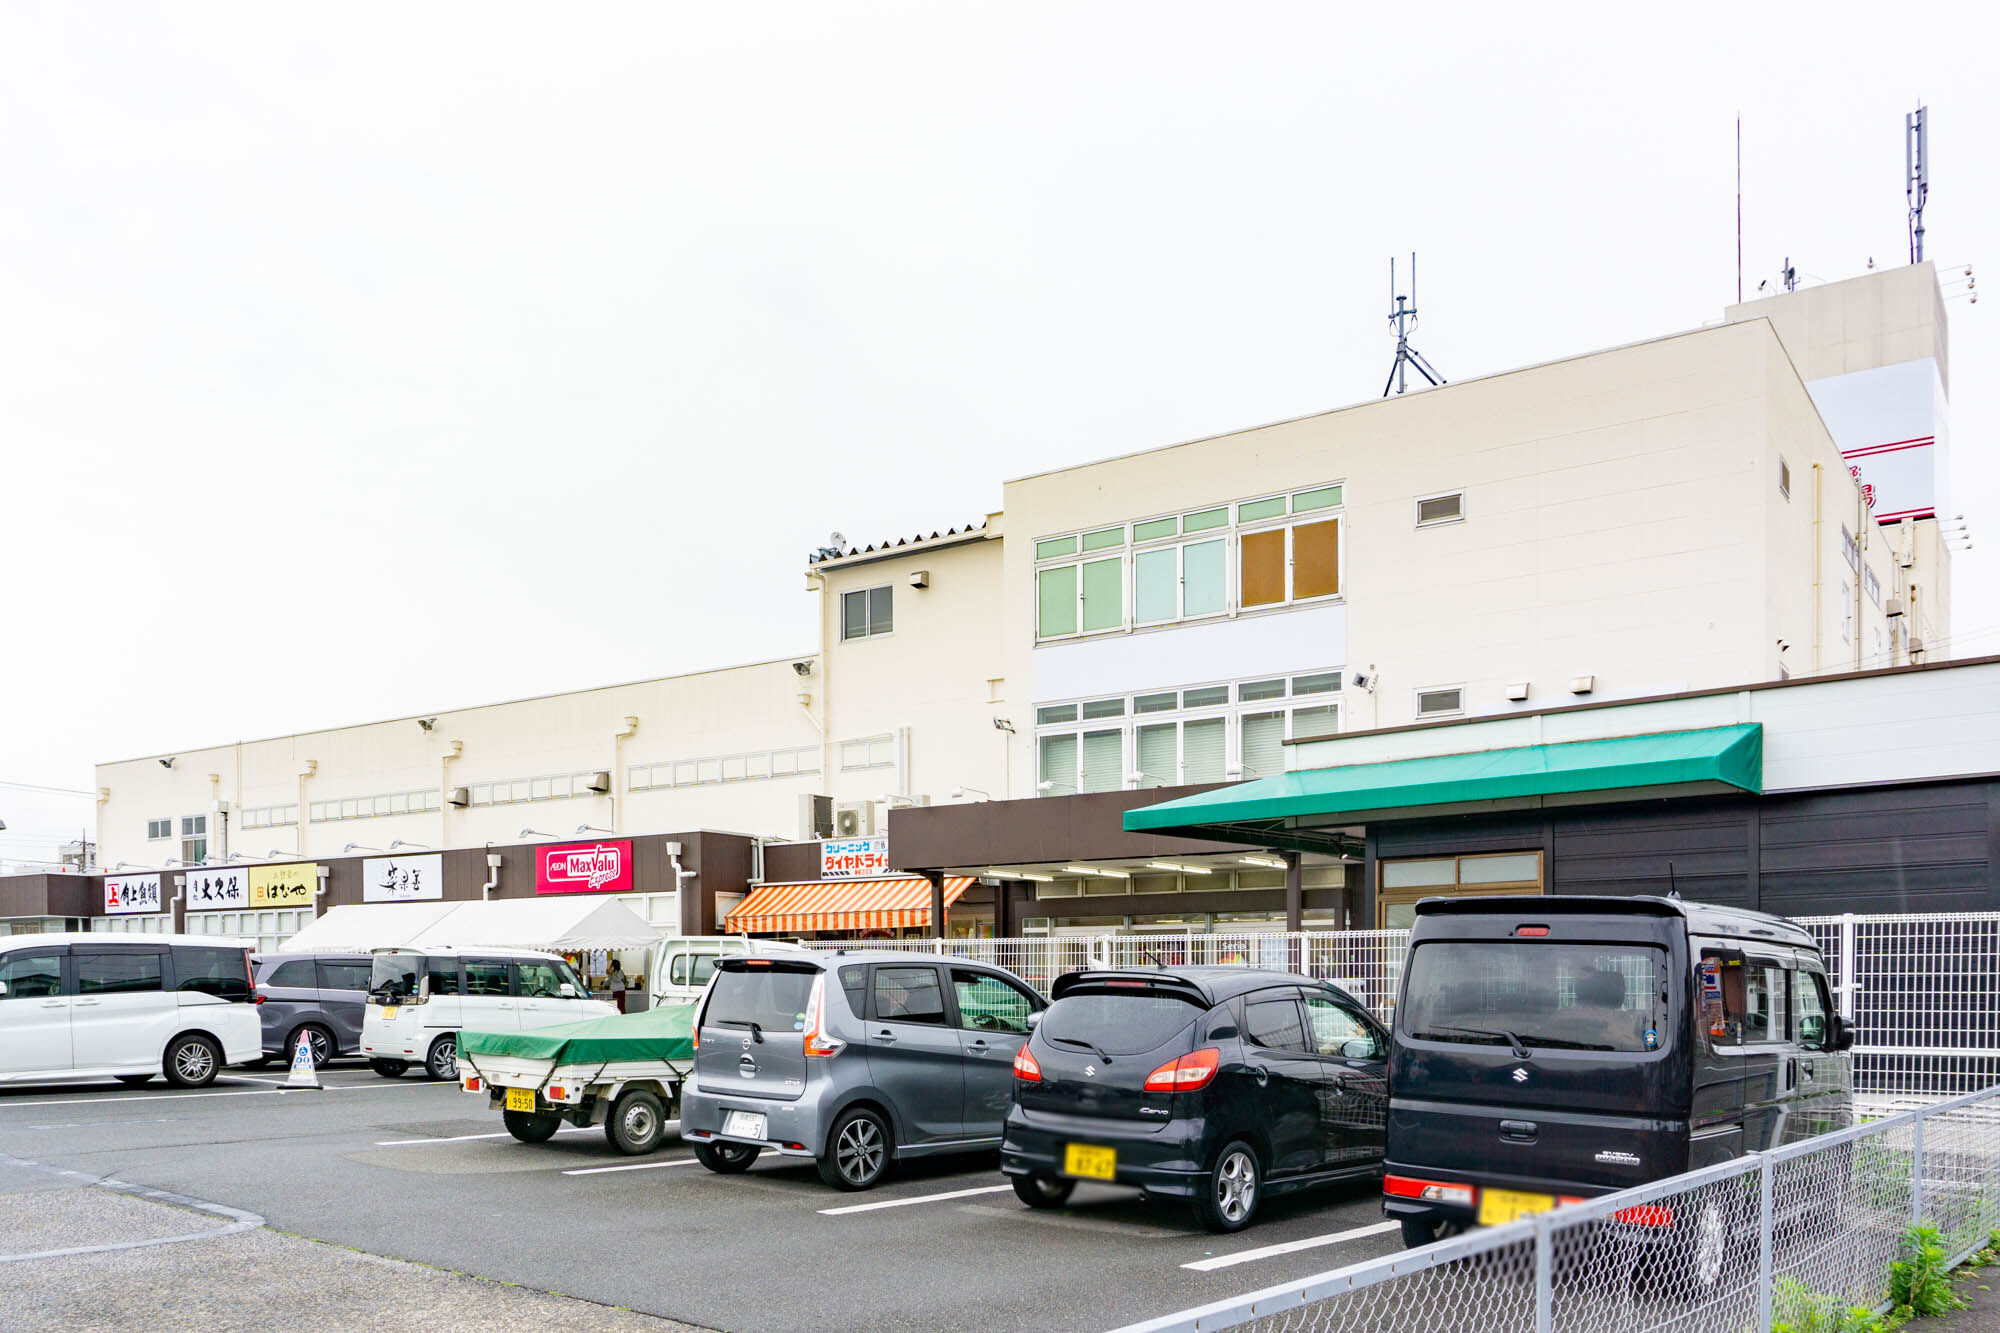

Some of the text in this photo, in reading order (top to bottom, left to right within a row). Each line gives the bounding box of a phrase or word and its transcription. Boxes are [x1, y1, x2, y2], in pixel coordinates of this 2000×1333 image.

[825, 841, 870, 853] クリーニング
[570, 846, 615, 873] MaxValu
[201, 876, 239, 900] 大久保
[267, 882, 306, 898] はなや
